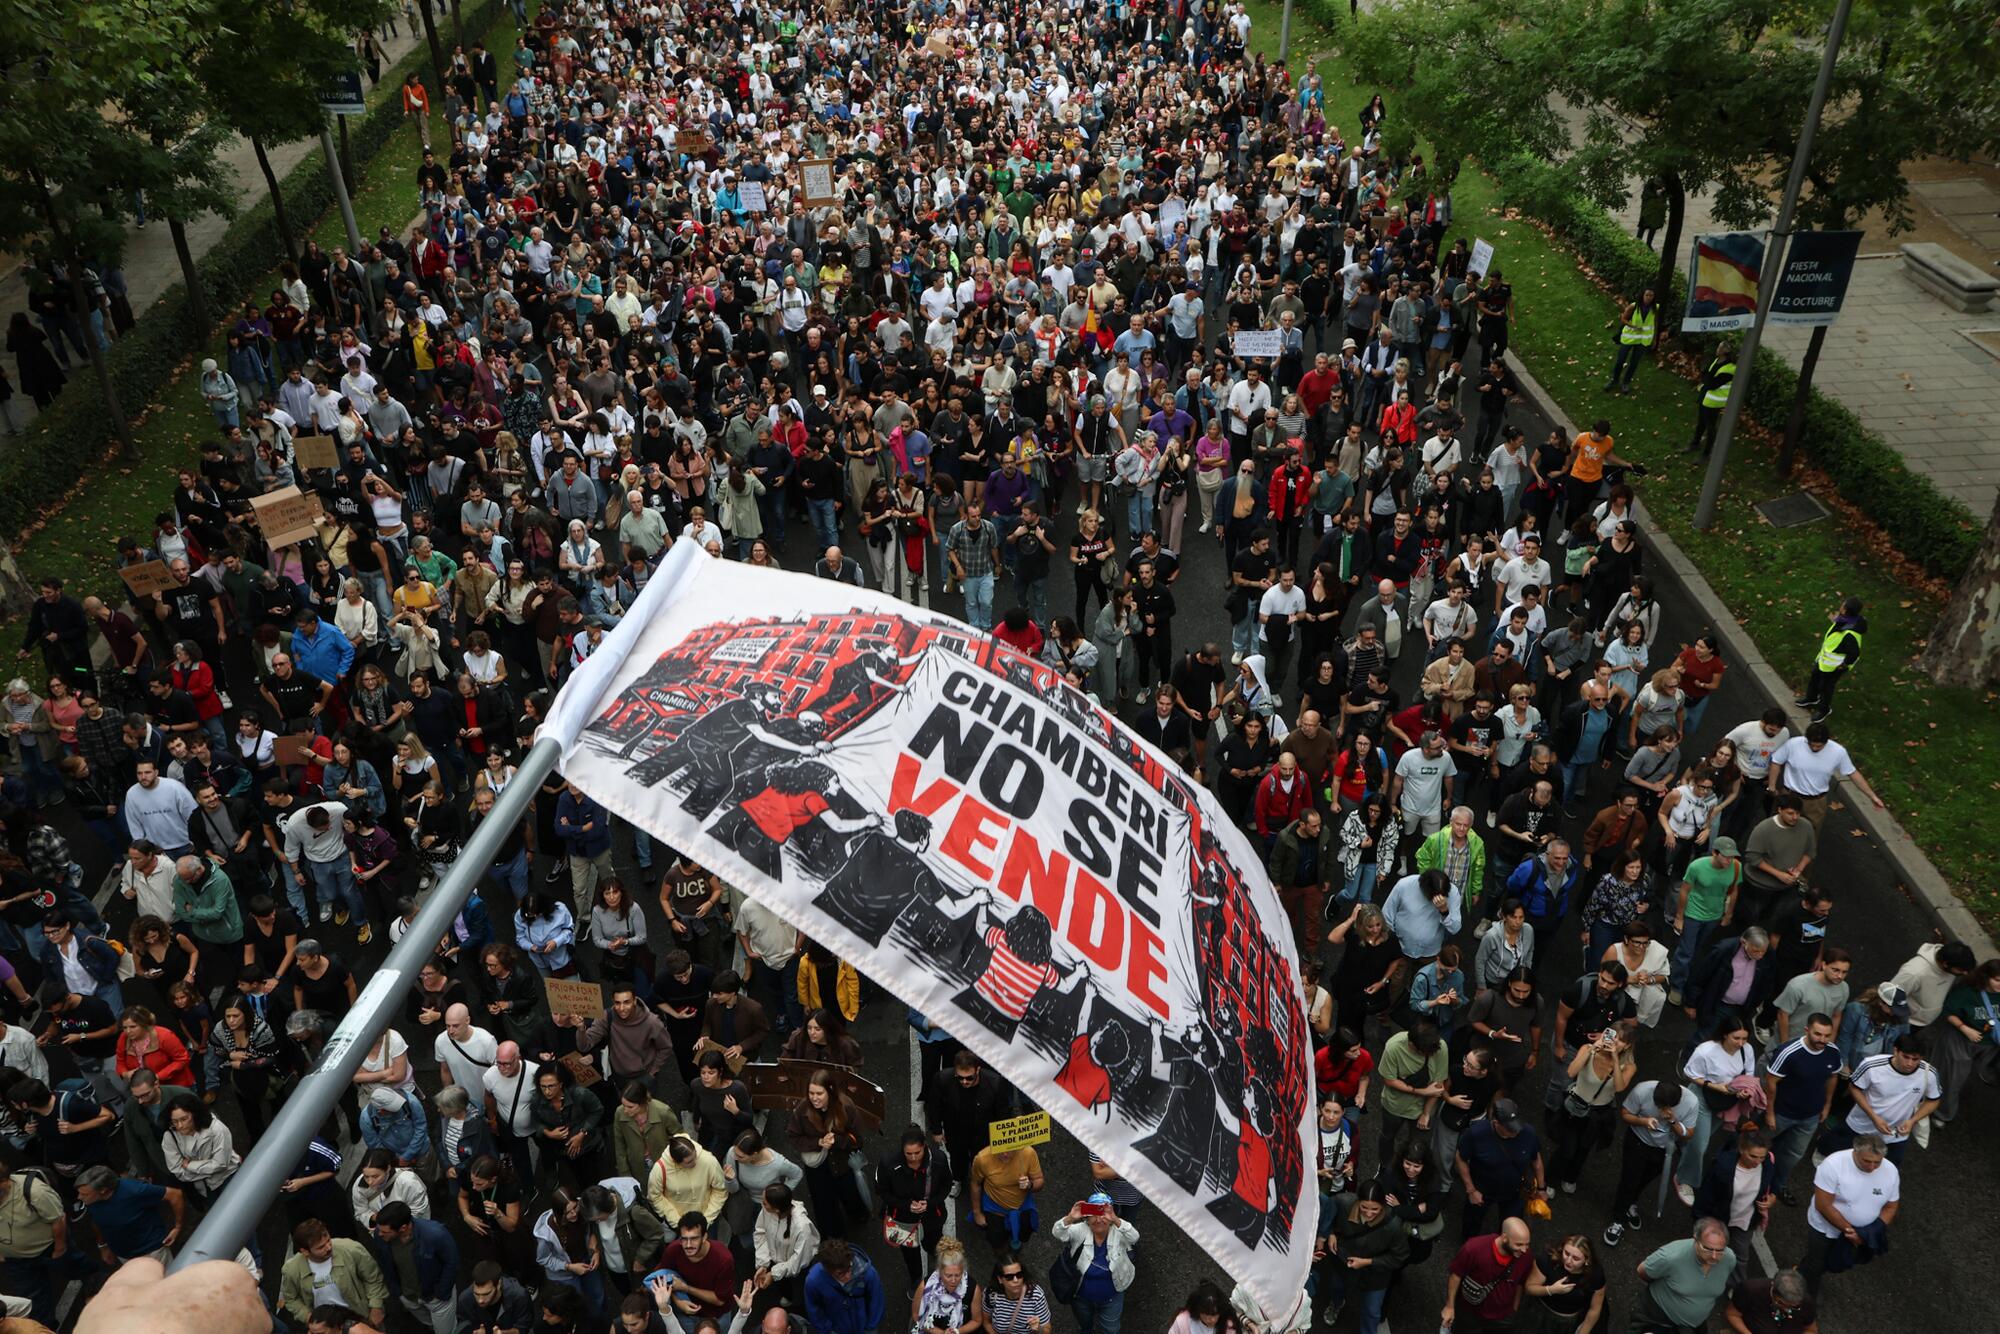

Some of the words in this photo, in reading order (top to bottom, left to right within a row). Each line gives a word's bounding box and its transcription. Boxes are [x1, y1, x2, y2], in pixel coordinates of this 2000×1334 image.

[1790, 261, 1818, 271] FIESTA
[1786, 272, 1833, 283] NACIONAL
[1779, 296, 1790, 306] 12
[1792, 295, 1836, 307] OCTUBRE
[1709, 319, 1740, 329] MADRID
[907, 702, 1044, 820] NO
[942, 671, 1169, 860] CHAMBERÍ
[1063, 798, 1163, 930] SE
[887, 752, 1170, 1021] VENDE
[549, 982, 599, 996] PRIORIDAD
[1018, 1113, 1044, 1126] HOGAR
[1008, 1122, 1039, 1136] PLANETA
[992, 1136, 1017, 1147] DONDE
[1018, 1127, 1049, 1142] HABITAR
